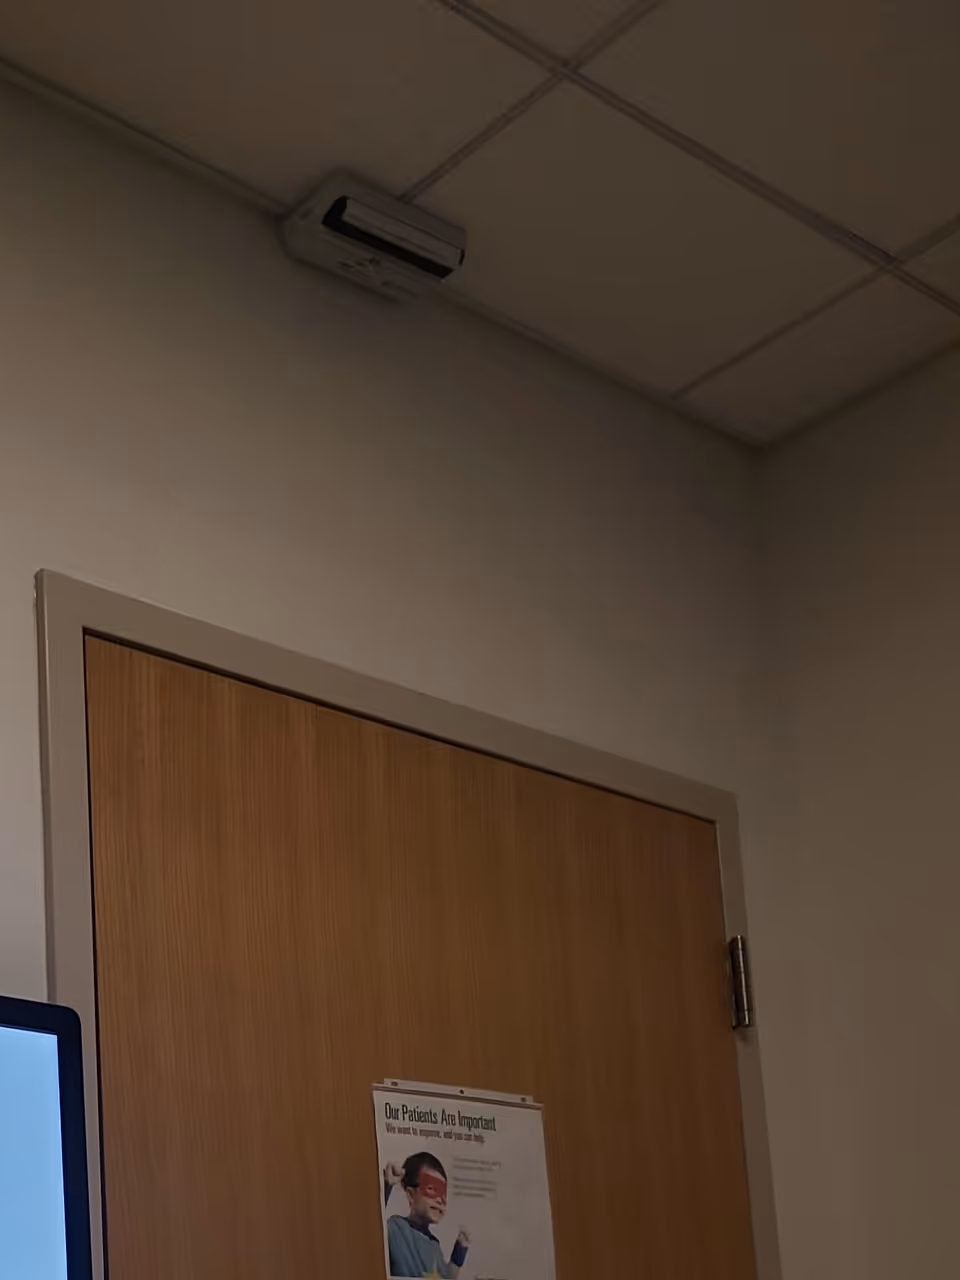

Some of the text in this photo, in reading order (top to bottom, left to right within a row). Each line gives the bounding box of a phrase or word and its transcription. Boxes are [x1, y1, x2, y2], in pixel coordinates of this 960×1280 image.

[385, 1102, 497, 1131] Our Patients Are Important
